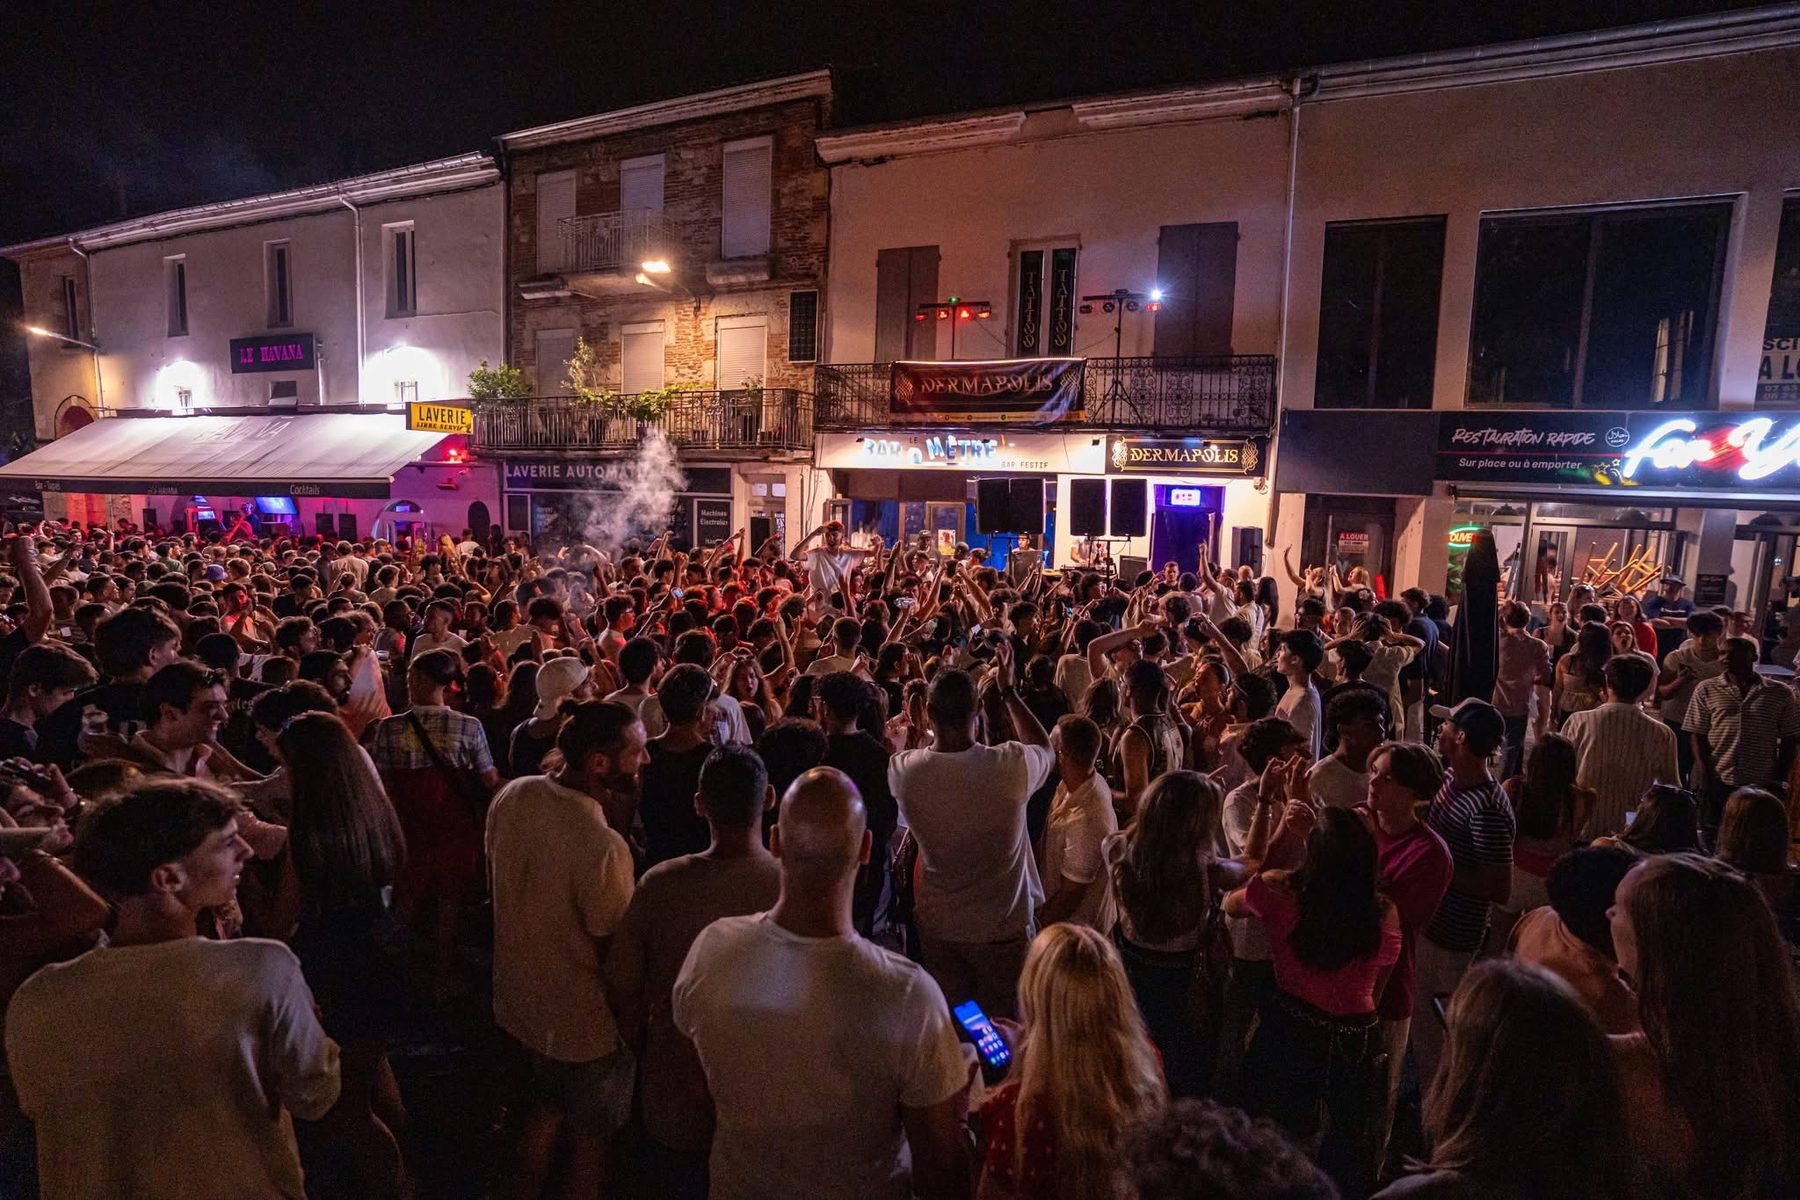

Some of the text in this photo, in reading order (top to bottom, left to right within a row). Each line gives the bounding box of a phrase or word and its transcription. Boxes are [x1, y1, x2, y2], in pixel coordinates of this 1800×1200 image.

[240, 344, 304, 364] LE HAVANA
[1782, 355, 1800, 380] L
[921, 374, 1053, 395] DERMAPOLIS
[419, 405, 466, 425] LAVERIE
[909, 436, 919, 444] LE
[864, 437, 903, 459] BAR
[1130, 447, 1239, 464] DERMAPOLIS
[1020, 461, 1049, 469] FESTIF
[1459, 458, 1583, 471] Sur place ou à emporter
[505, 465, 561, 478] LAVERIE
[289, 484, 321, 496] Cocktails
[701, 509, 728, 517] Machines
[1346, 533, 1369, 541] LOUER
[1449, 532, 1473, 543] OUVE
